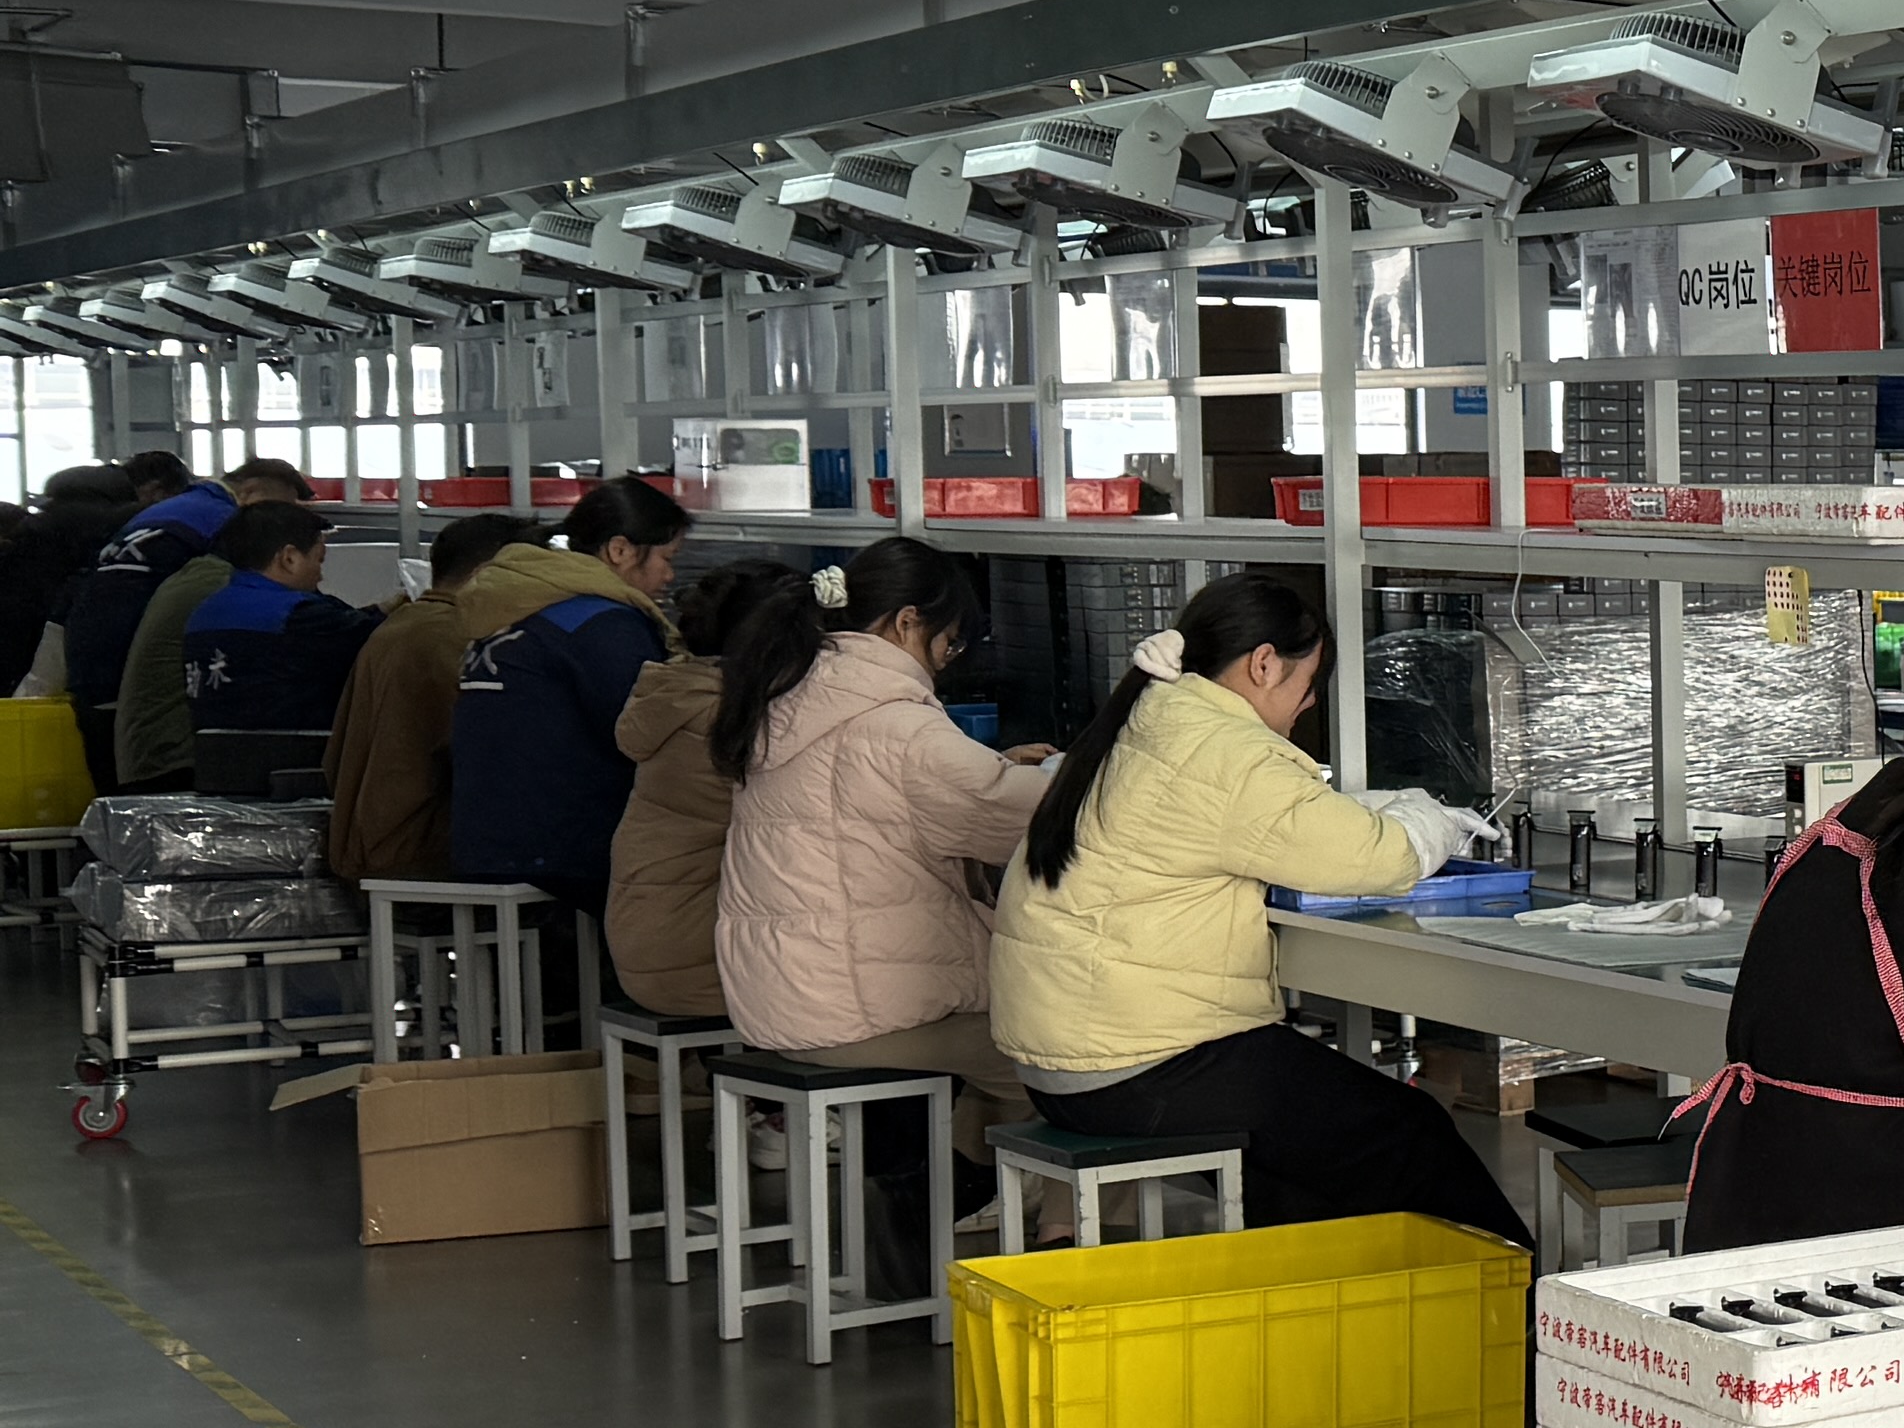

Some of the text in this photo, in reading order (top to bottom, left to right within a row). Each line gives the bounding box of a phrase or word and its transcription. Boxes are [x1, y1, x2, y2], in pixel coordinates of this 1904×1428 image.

[1777, 250, 1872, 298] 关键岗位
[1539, 1311, 1691, 1386] 宁波帝客汽车配件有限公司
